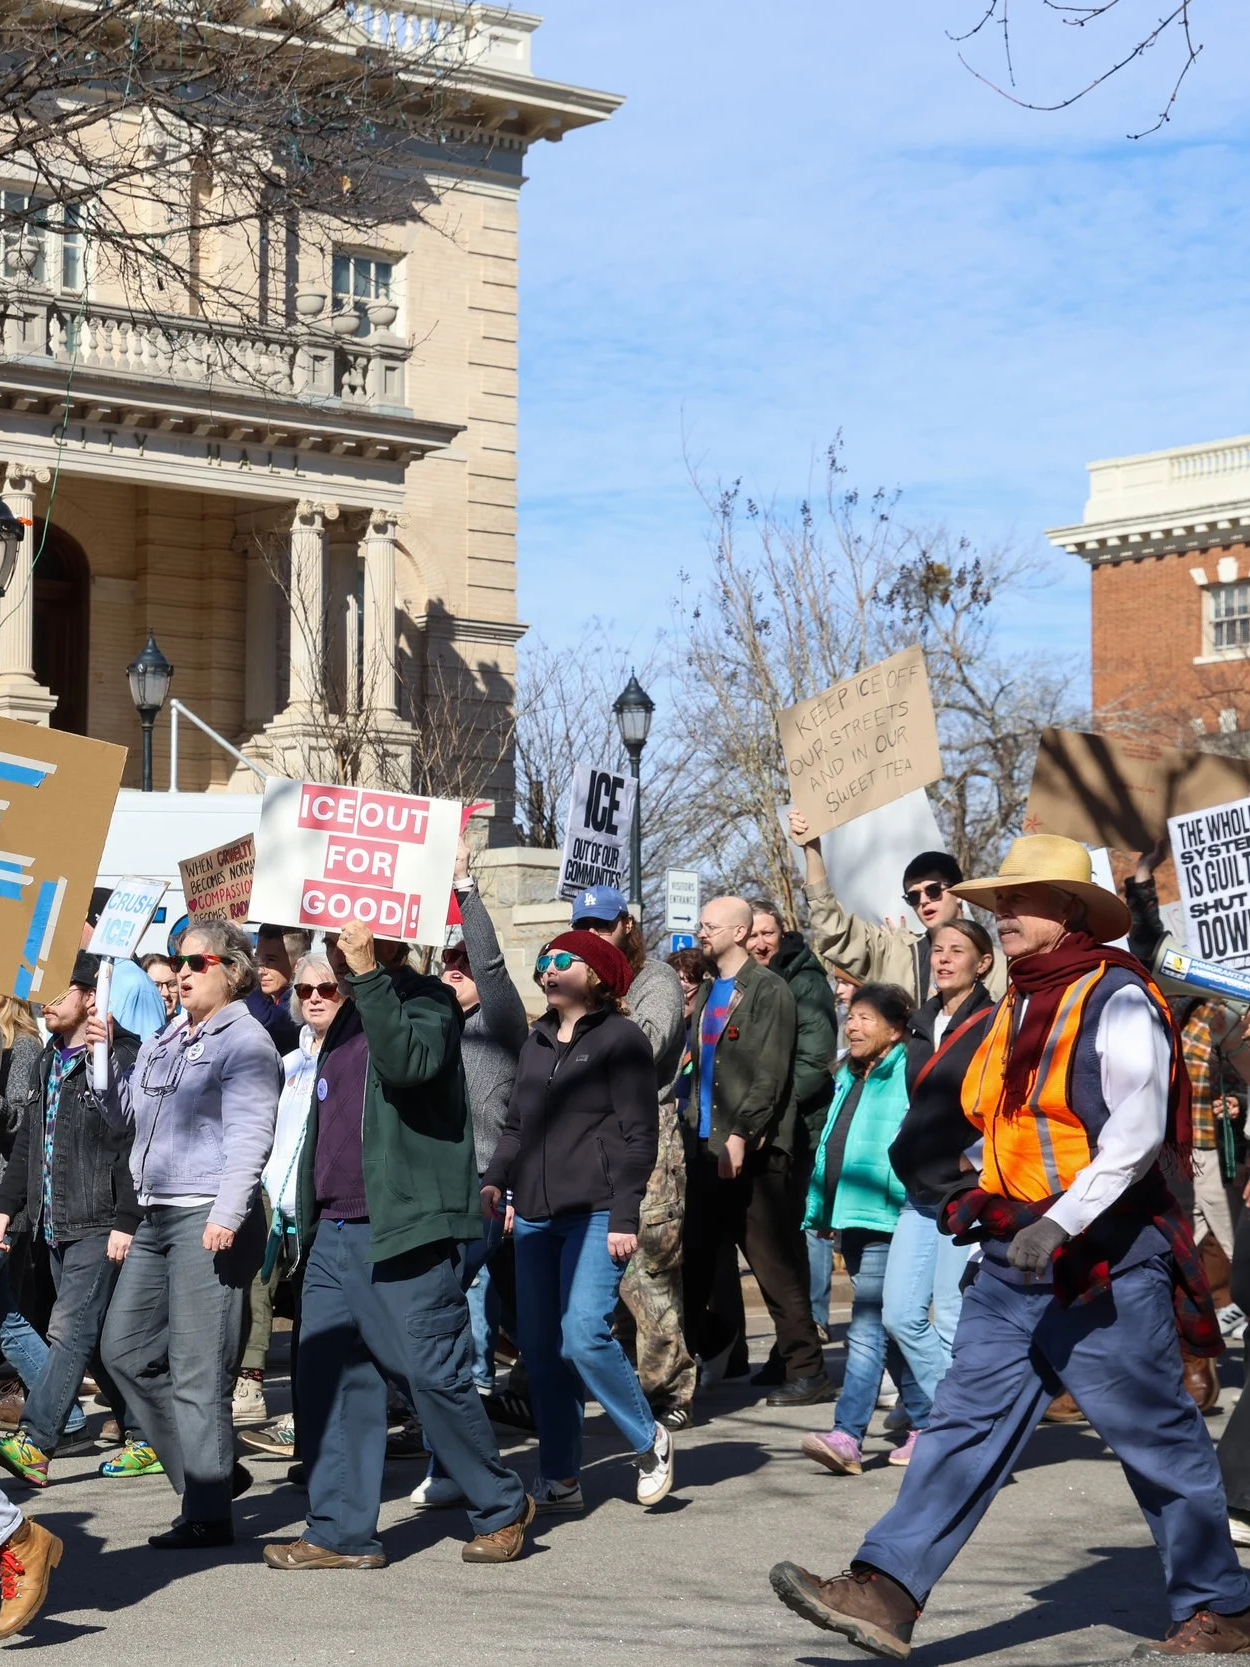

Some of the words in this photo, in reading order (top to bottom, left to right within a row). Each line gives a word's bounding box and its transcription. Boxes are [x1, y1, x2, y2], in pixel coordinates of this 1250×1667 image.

[51, 423, 148, 457] CITY
[206, 443, 306, 478] HALL
[794, 687, 848, 740] KEEP
[855, 673, 883, 702] ICE
[886, 665, 921, 689] OFF
[789, 737, 828, 777] OUR
[829, 701, 910, 748] STREETS
[810, 757, 845, 793] AND
[852, 743, 868, 764] IN
[875, 725, 909, 754] OUR
[584, 770, 625, 836] ICE
[825, 768, 877, 814] SWEET
[881, 758, 913, 779] TEA
[301, 793, 356, 824] ICE
[359, 802, 430, 835] OUT
[1177, 818, 1206, 850] THE
[1205, 804, 1250, 841] WHOL
[185, 855, 213, 878] WHEN
[216, 839, 252, 867] CRUELTY
[326, 845, 393, 878] FOR
[572, 837, 592, 862] OUT
[590, 842, 603, 865] OF
[601, 844, 620, 870] OUR
[190, 870, 226, 895] BECOMES
[229, 858, 256, 880] NORMA
[564, 859, 621, 890] COMMUNITIES
[1184, 861, 1204, 899] IS
[107, 891, 158, 915] CRUSH
[193, 906, 227, 923] BECOMES
[669, 894, 696, 906] ENTRANCE
[1189, 892, 1248, 919] SHUT
[99, 917, 136, 947] ICE!
[1197, 908, 1250, 960] DOW
